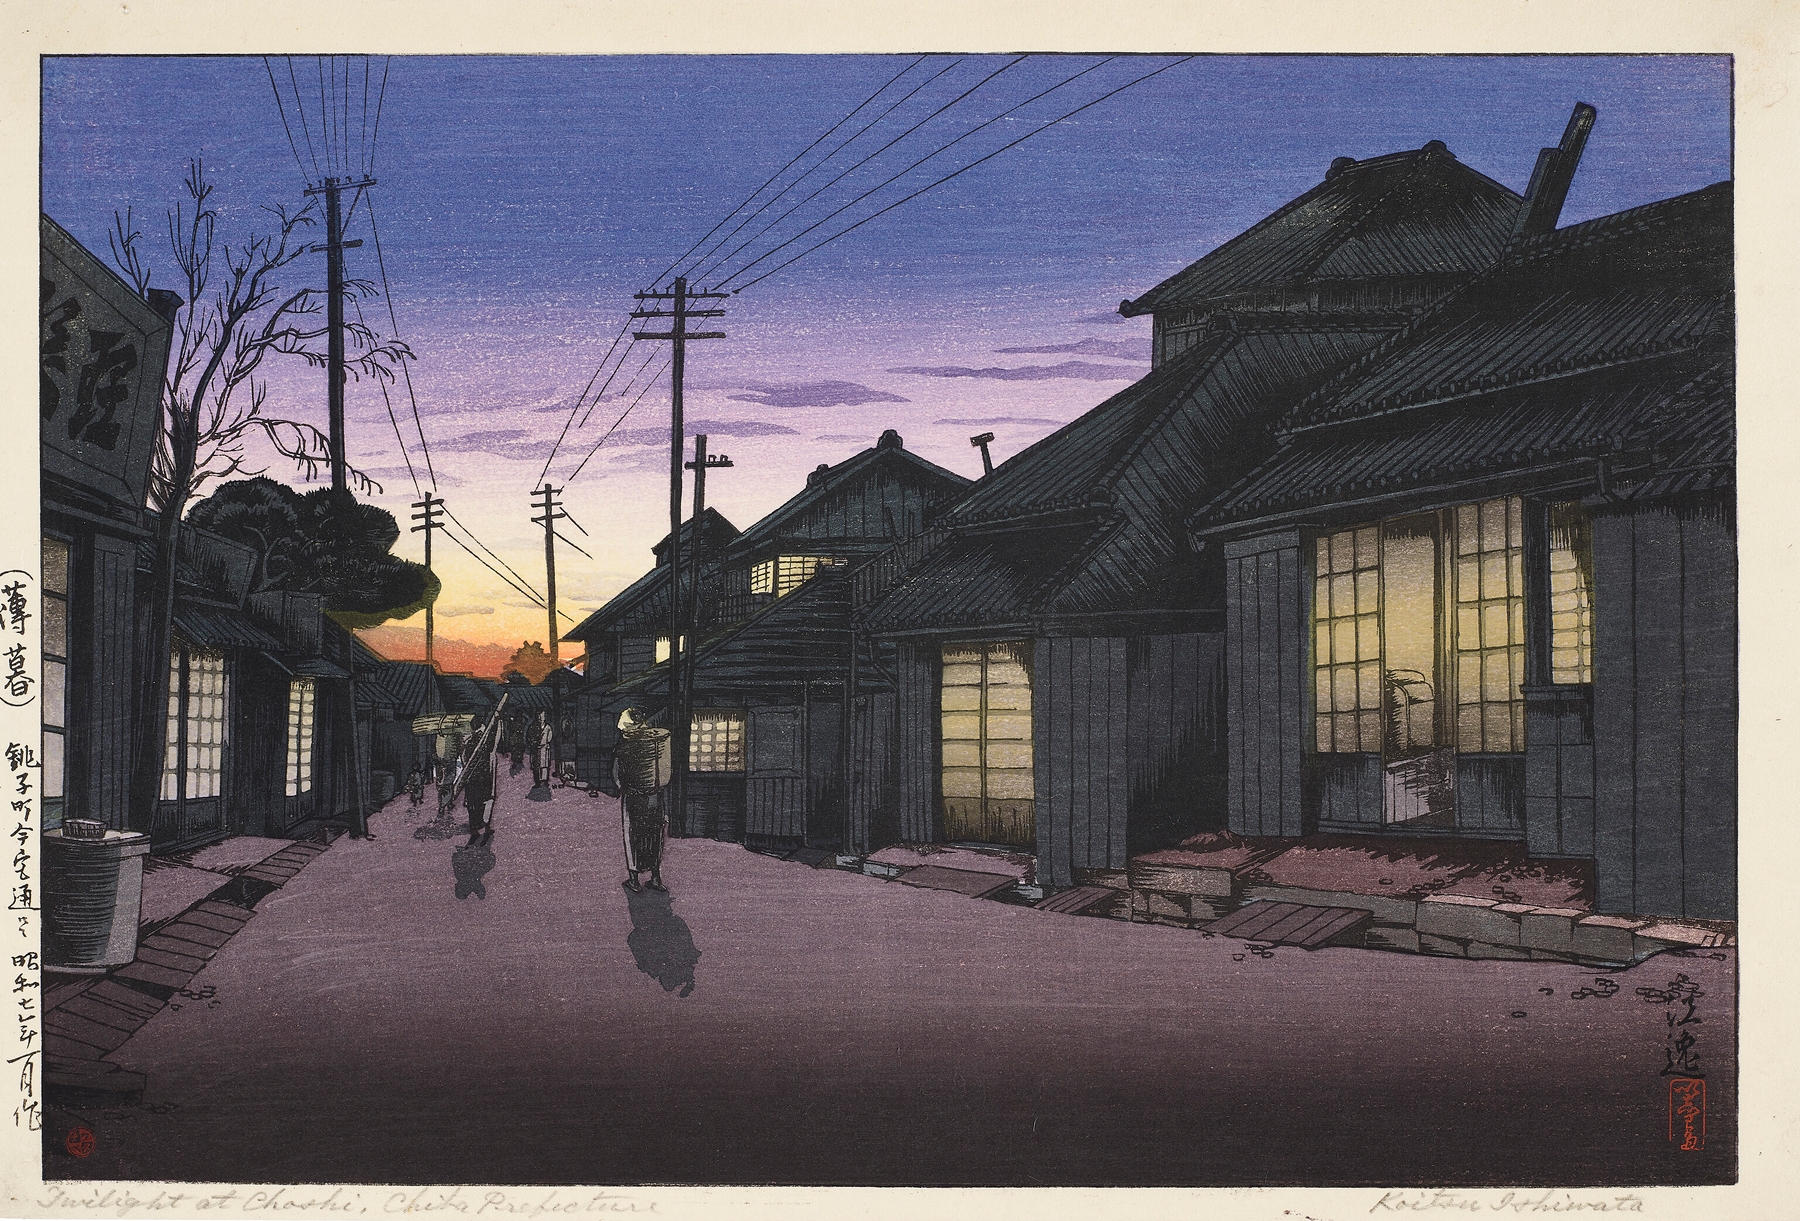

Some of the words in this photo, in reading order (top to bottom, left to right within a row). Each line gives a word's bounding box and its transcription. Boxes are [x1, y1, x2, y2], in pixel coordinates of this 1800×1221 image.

[37, 1186, 190, 1216] Twilight
[196, 1188, 243, 1210] at
[383, 1187, 469, 1213] Chiba
[477, 1190, 661, 1218] Prefecture
[1369, 1188, 1482, 1213] Koitsu
[1489, 1190, 1644, 1213] Ishiwata
